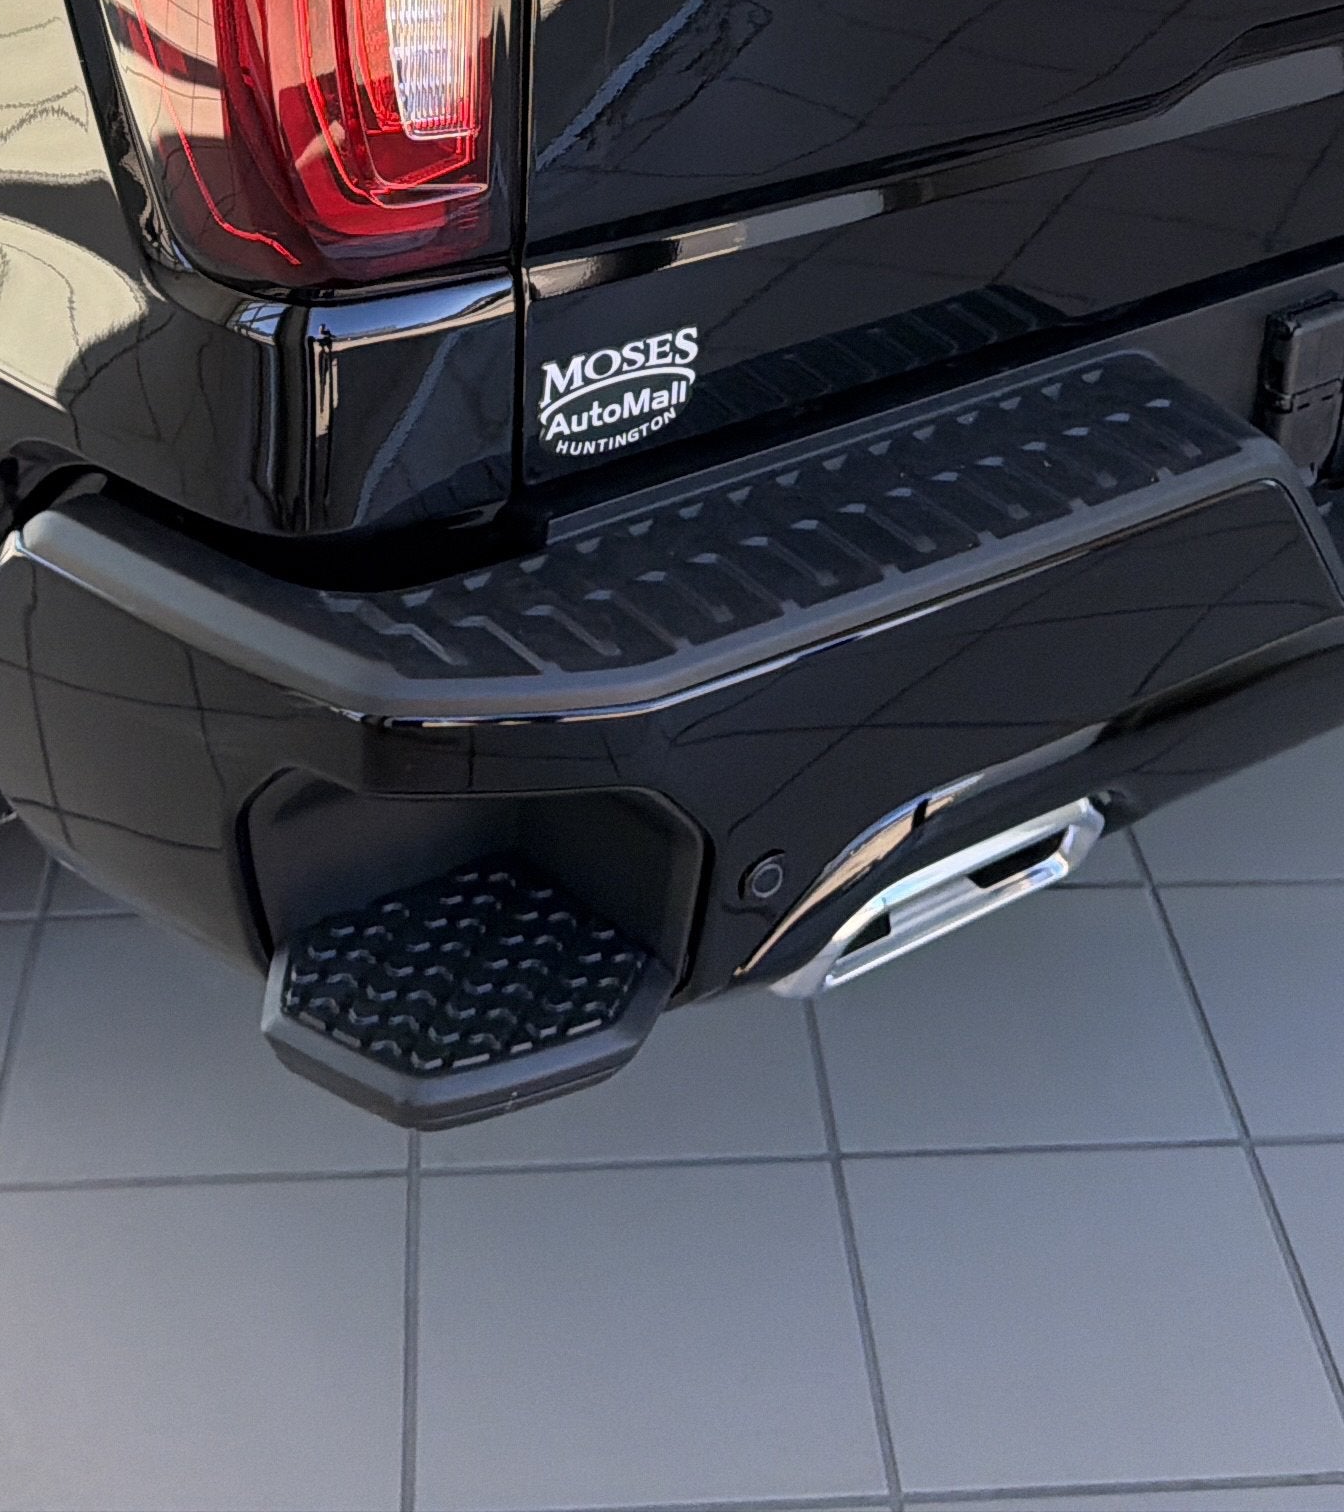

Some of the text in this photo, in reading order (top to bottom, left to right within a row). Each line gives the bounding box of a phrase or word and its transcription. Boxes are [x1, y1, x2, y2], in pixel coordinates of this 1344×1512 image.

[540, 326, 699, 409] MOSES
[545, 380, 687, 441] AutoMall
[555, 406, 677, 456] HUNTINGTON
